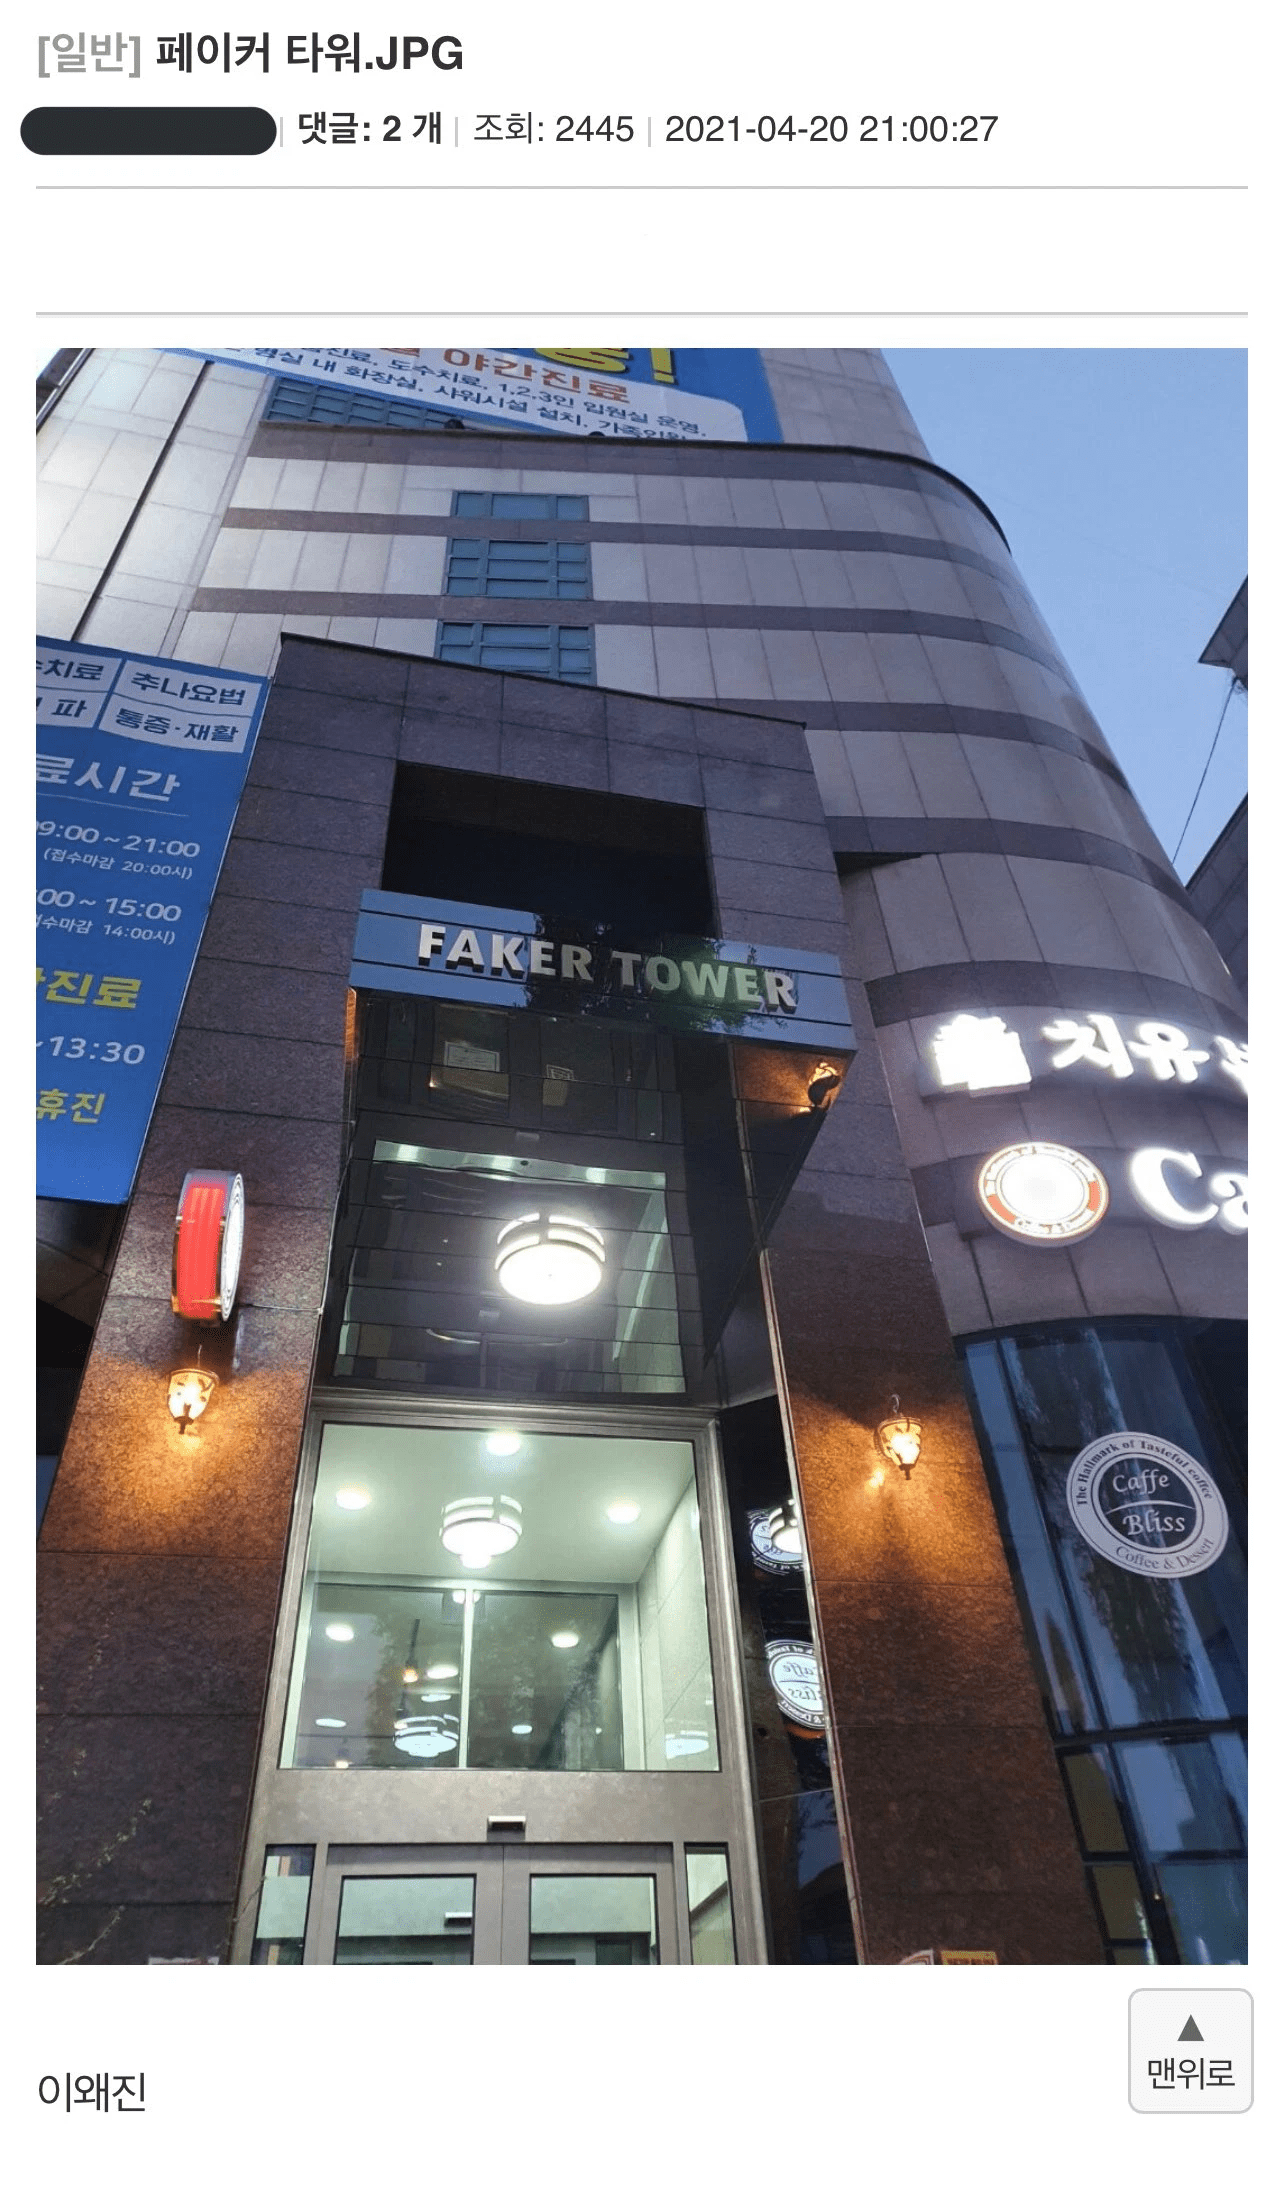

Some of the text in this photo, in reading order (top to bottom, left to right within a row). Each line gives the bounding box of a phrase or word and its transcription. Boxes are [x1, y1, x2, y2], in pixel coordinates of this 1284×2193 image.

[312, 359, 337, 373] 내
[434, 385, 527, 413] 샤워시설
[444, 348, 630, 403] 야간진료
[130, 671, 246, 707] 추나요법
[43, 847, 194, 880] (접수마감 20:00시)
[103, 924, 176, 946] 14:00시)
[418, 923, 798, 1015] FAKER TOWER
[36, 1088, 106, 1124] 휴진
[1122, 1440, 1135, 1449] of
[1140, 1440, 1189, 1469] Tasteful
[1078, 1443, 1120, 1484] Hallmark
[1075, 1485, 1088, 1505] The
[1112, 1468, 1171, 1495] Caffe
[1122, 1509, 1185, 1536] Bliss
[1116, 1538, 1214, 1570] Coffee & Dessert
